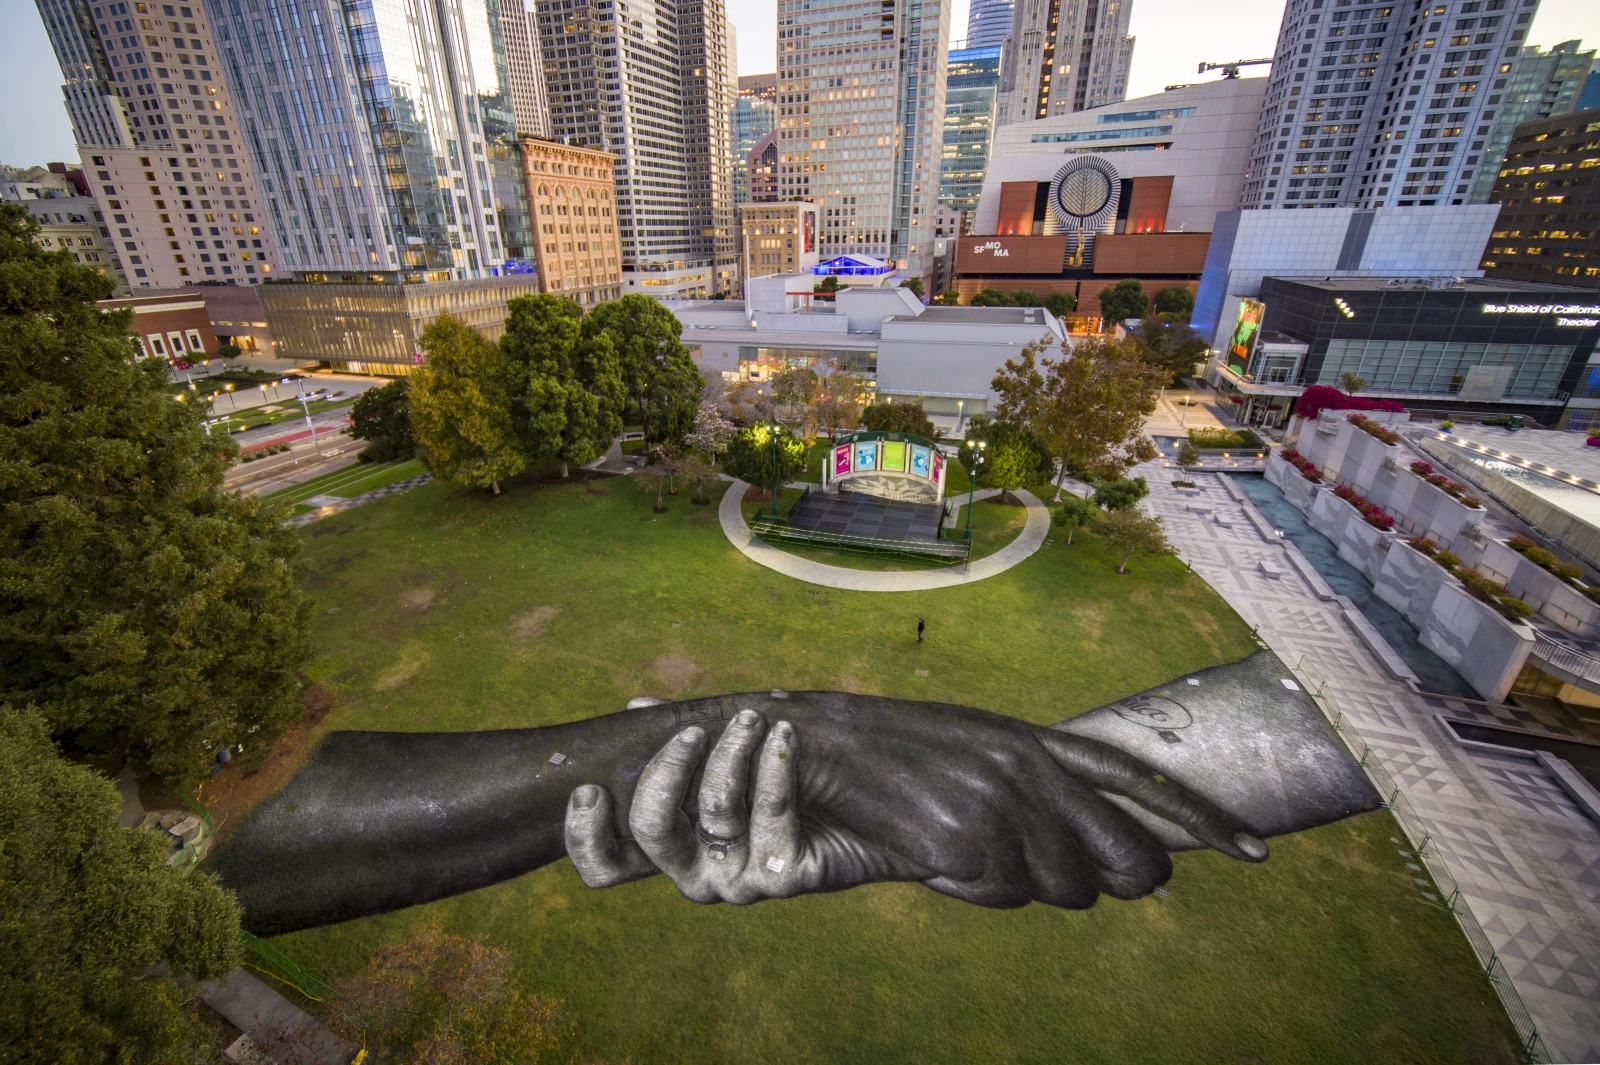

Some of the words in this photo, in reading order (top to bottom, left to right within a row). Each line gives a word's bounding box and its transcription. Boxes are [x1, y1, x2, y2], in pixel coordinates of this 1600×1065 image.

[1483, 303, 1506, 314] Blue
[1506, 303, 1539, 314] Shield
[1540, 304, 1554, 314] of
[1557, 317, 1599, 327] Theater
